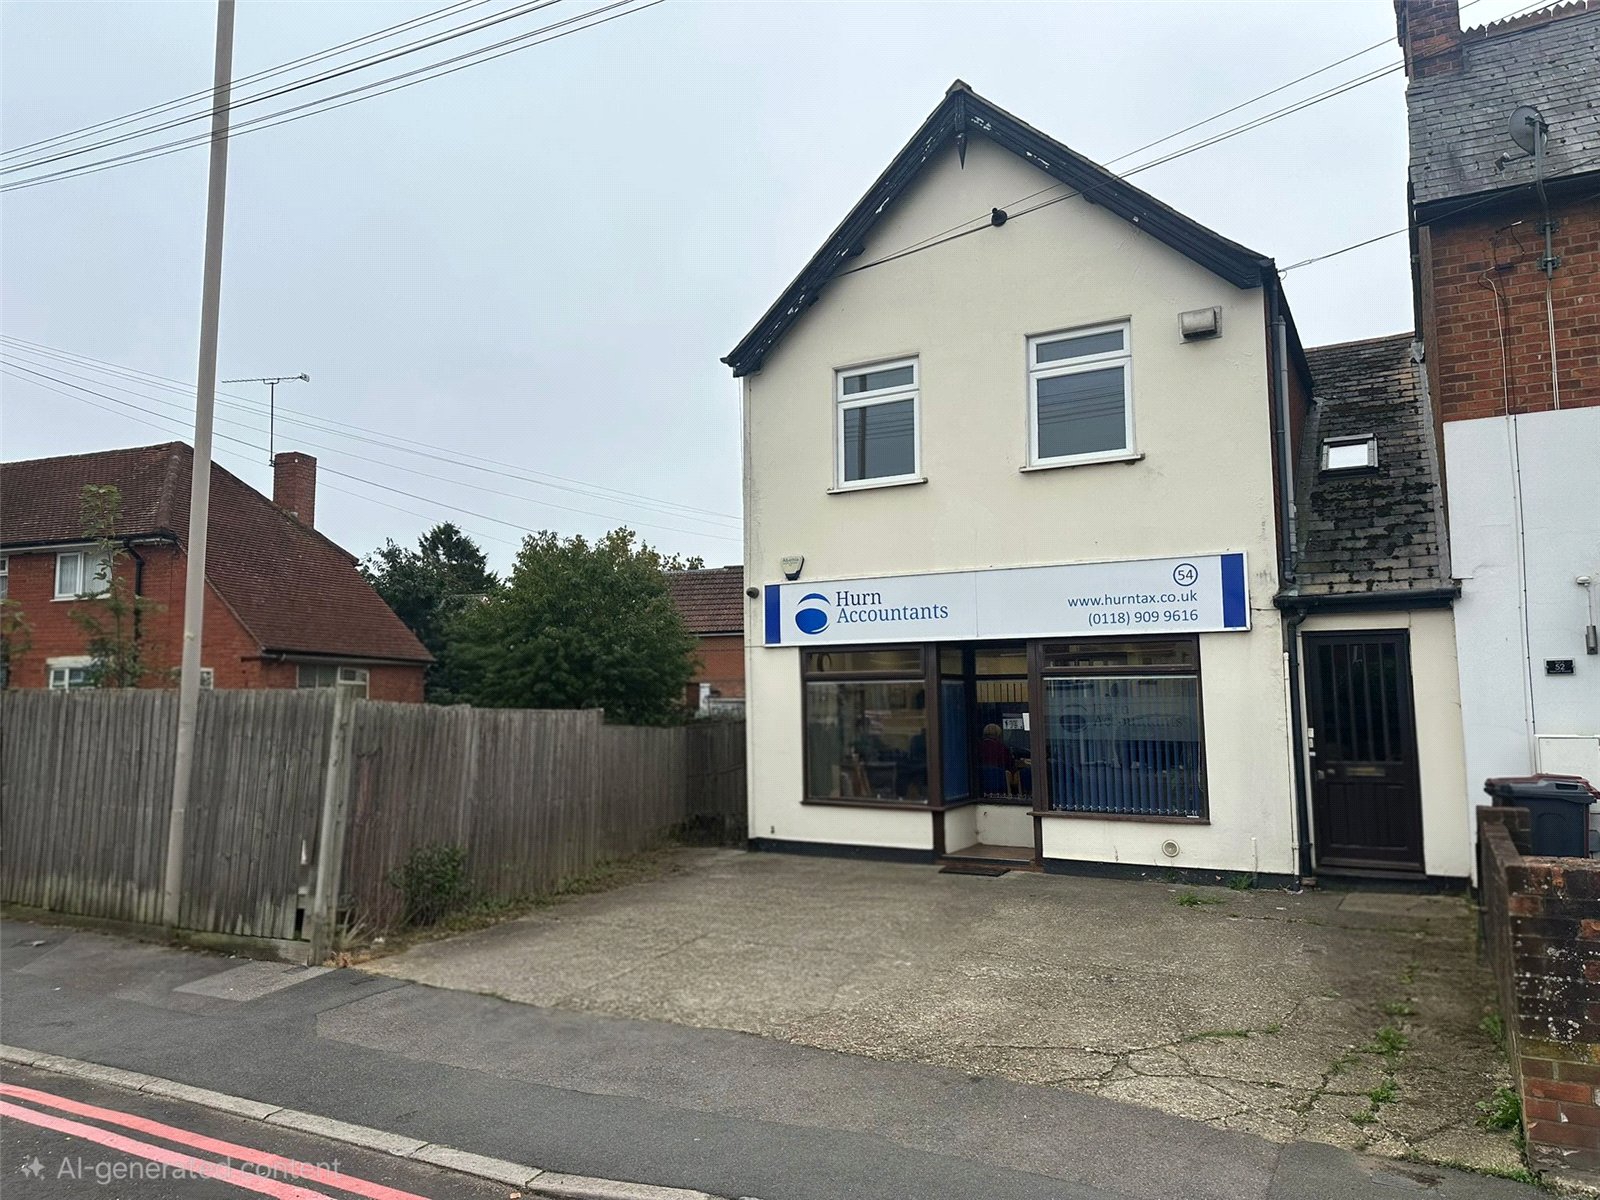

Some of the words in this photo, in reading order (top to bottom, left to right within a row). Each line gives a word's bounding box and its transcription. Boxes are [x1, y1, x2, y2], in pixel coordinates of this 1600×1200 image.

[1177, 569, 1194, 581] 54
[836, 590, 882, 607] Hurn
[1067, 590, 1198, 607] www.hurntax.co.uk
[836, 604, 949, 624] Accountants
[1088, 611, 1130, 627] (0118)
[1134, 611, 1159, 623] 909
[1164, 609, 1198, 622] 9616
[1555, 663, 1565, 671] 52
